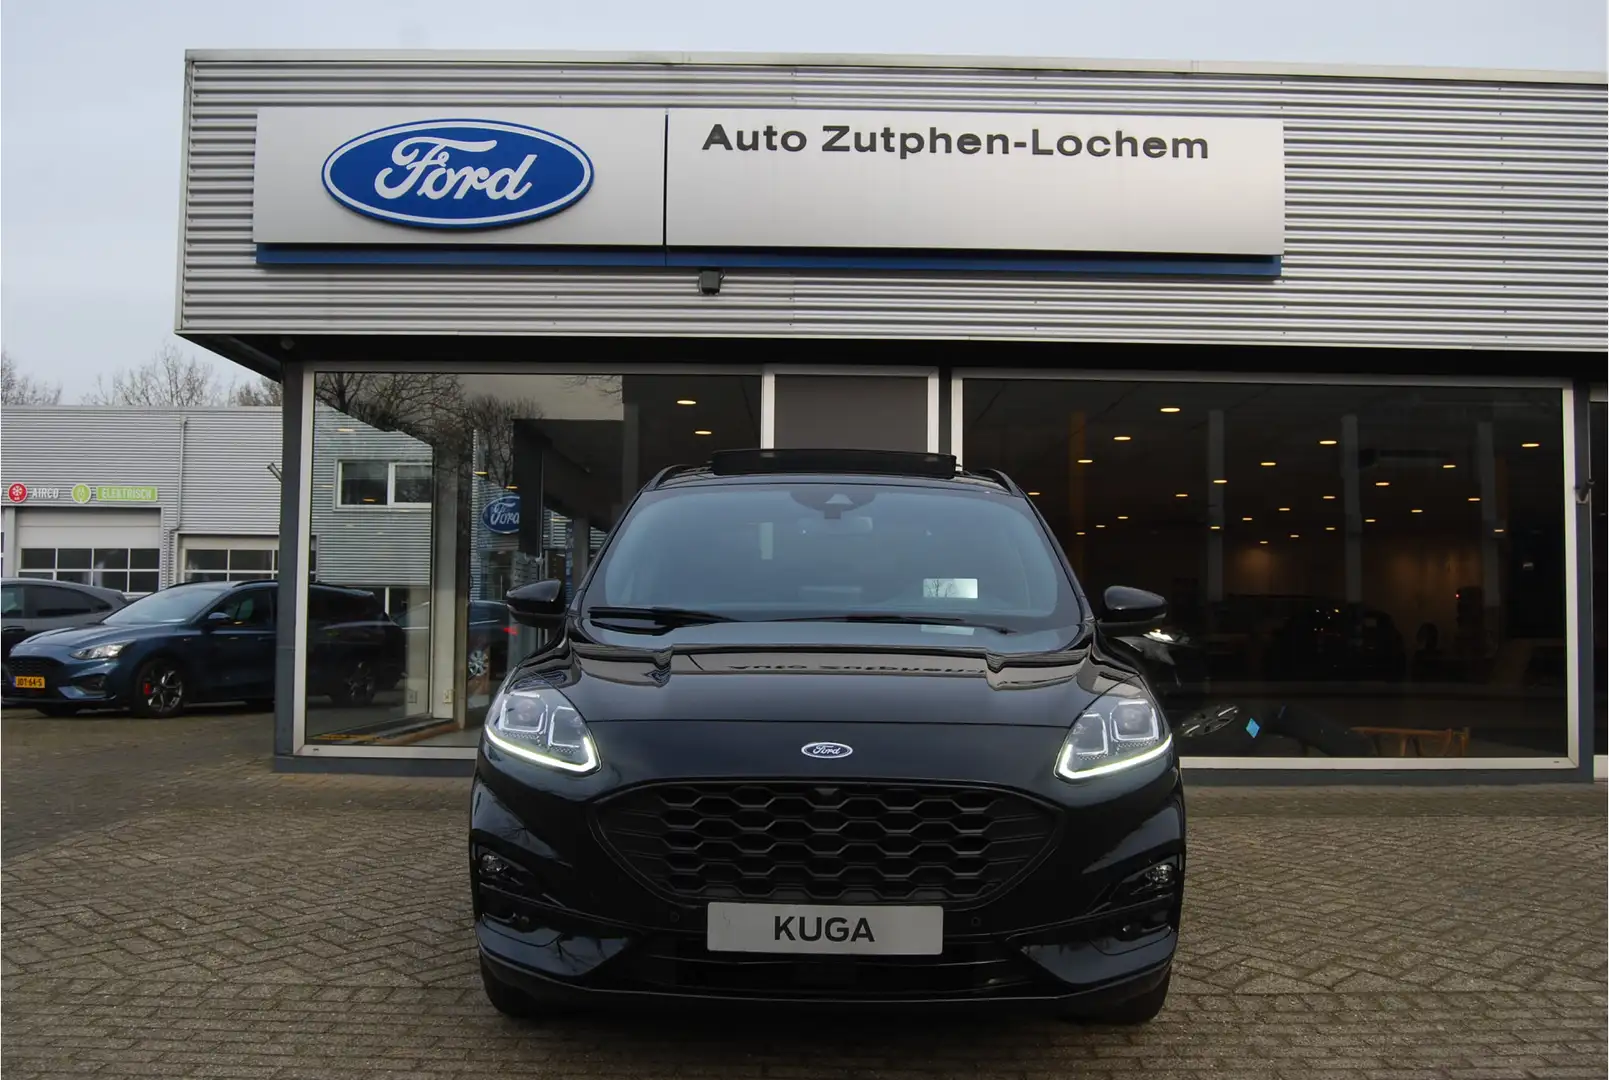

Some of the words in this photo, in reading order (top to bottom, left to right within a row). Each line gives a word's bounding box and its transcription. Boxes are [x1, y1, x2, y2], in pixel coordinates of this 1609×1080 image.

[702, 123, 808, 151] Auto
[821, 125, 1209, 160] Zutphen-Lochem
[374, 136, 538, 200] Ford
[31, 487, 59, 499] AIRCO
[102, 487, 152, 499] ELEKTRISCH
[812, 745, 841, 755] Ford
[774, 915, 875, 942] KUGA
